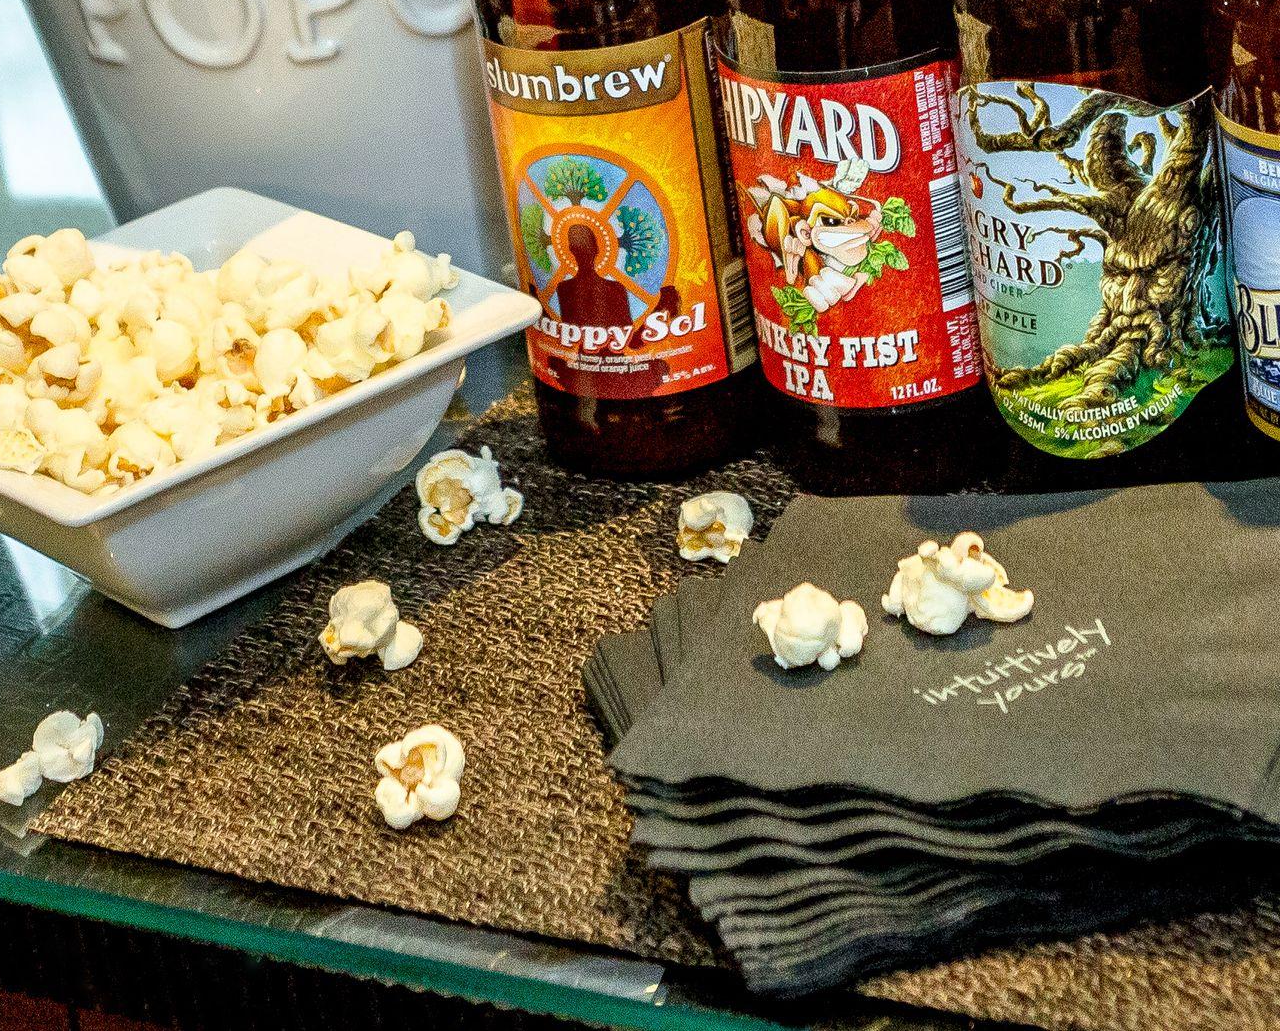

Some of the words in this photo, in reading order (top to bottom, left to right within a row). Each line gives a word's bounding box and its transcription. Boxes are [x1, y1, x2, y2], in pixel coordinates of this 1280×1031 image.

[486, 56, 667, 103] slumbrew
[913, 70, 925, 81] BY
[924, 72, 938, 108] BREWING
[915, 81, 928, 113] BOTTLED
[720, 75, 902, 175] HIPYARD
[918, 111, 929, 121] &
[928, 108, 942, 144] SHIPYARD
[920, 120, 933, 152] BREWED
[972, 208, 1032, 252] GRY
[970, 234, 1065, 287] CHARD
[989, 278, 1024, 299] CIDER
[642, 301, 708, 342] Sol
[995, 309, 1038, 330] APPLE
[756, 315, 831, 367] NKEY
[839, 328, 920, 369] FIST
[600, 364, 628, 374] orange
[629, 362, 650, 374] juice
[661, 371, 691, 384] 5.5%
[782, 359, 835, 401] IPA
[1012, 388, 1064, 421] NATURALLY
[1065, 405, 1111, 424] GLUTEN
[1111, 395, 1139, 417] FREE
[1251, 378, 1278, 404] BLUE
[1018, 410, 1047, 435] 355ML
[1054, 426, 1071, 441] 5%
[1071, 421, 1126, 441] ALCOHOL
[1127, 412, 1142, 430] BY
[1140, 383, 1184, 421] VOLUME
[912, 618, 1112, 706] intuitively
[976, 661, 1087, 715] yours
